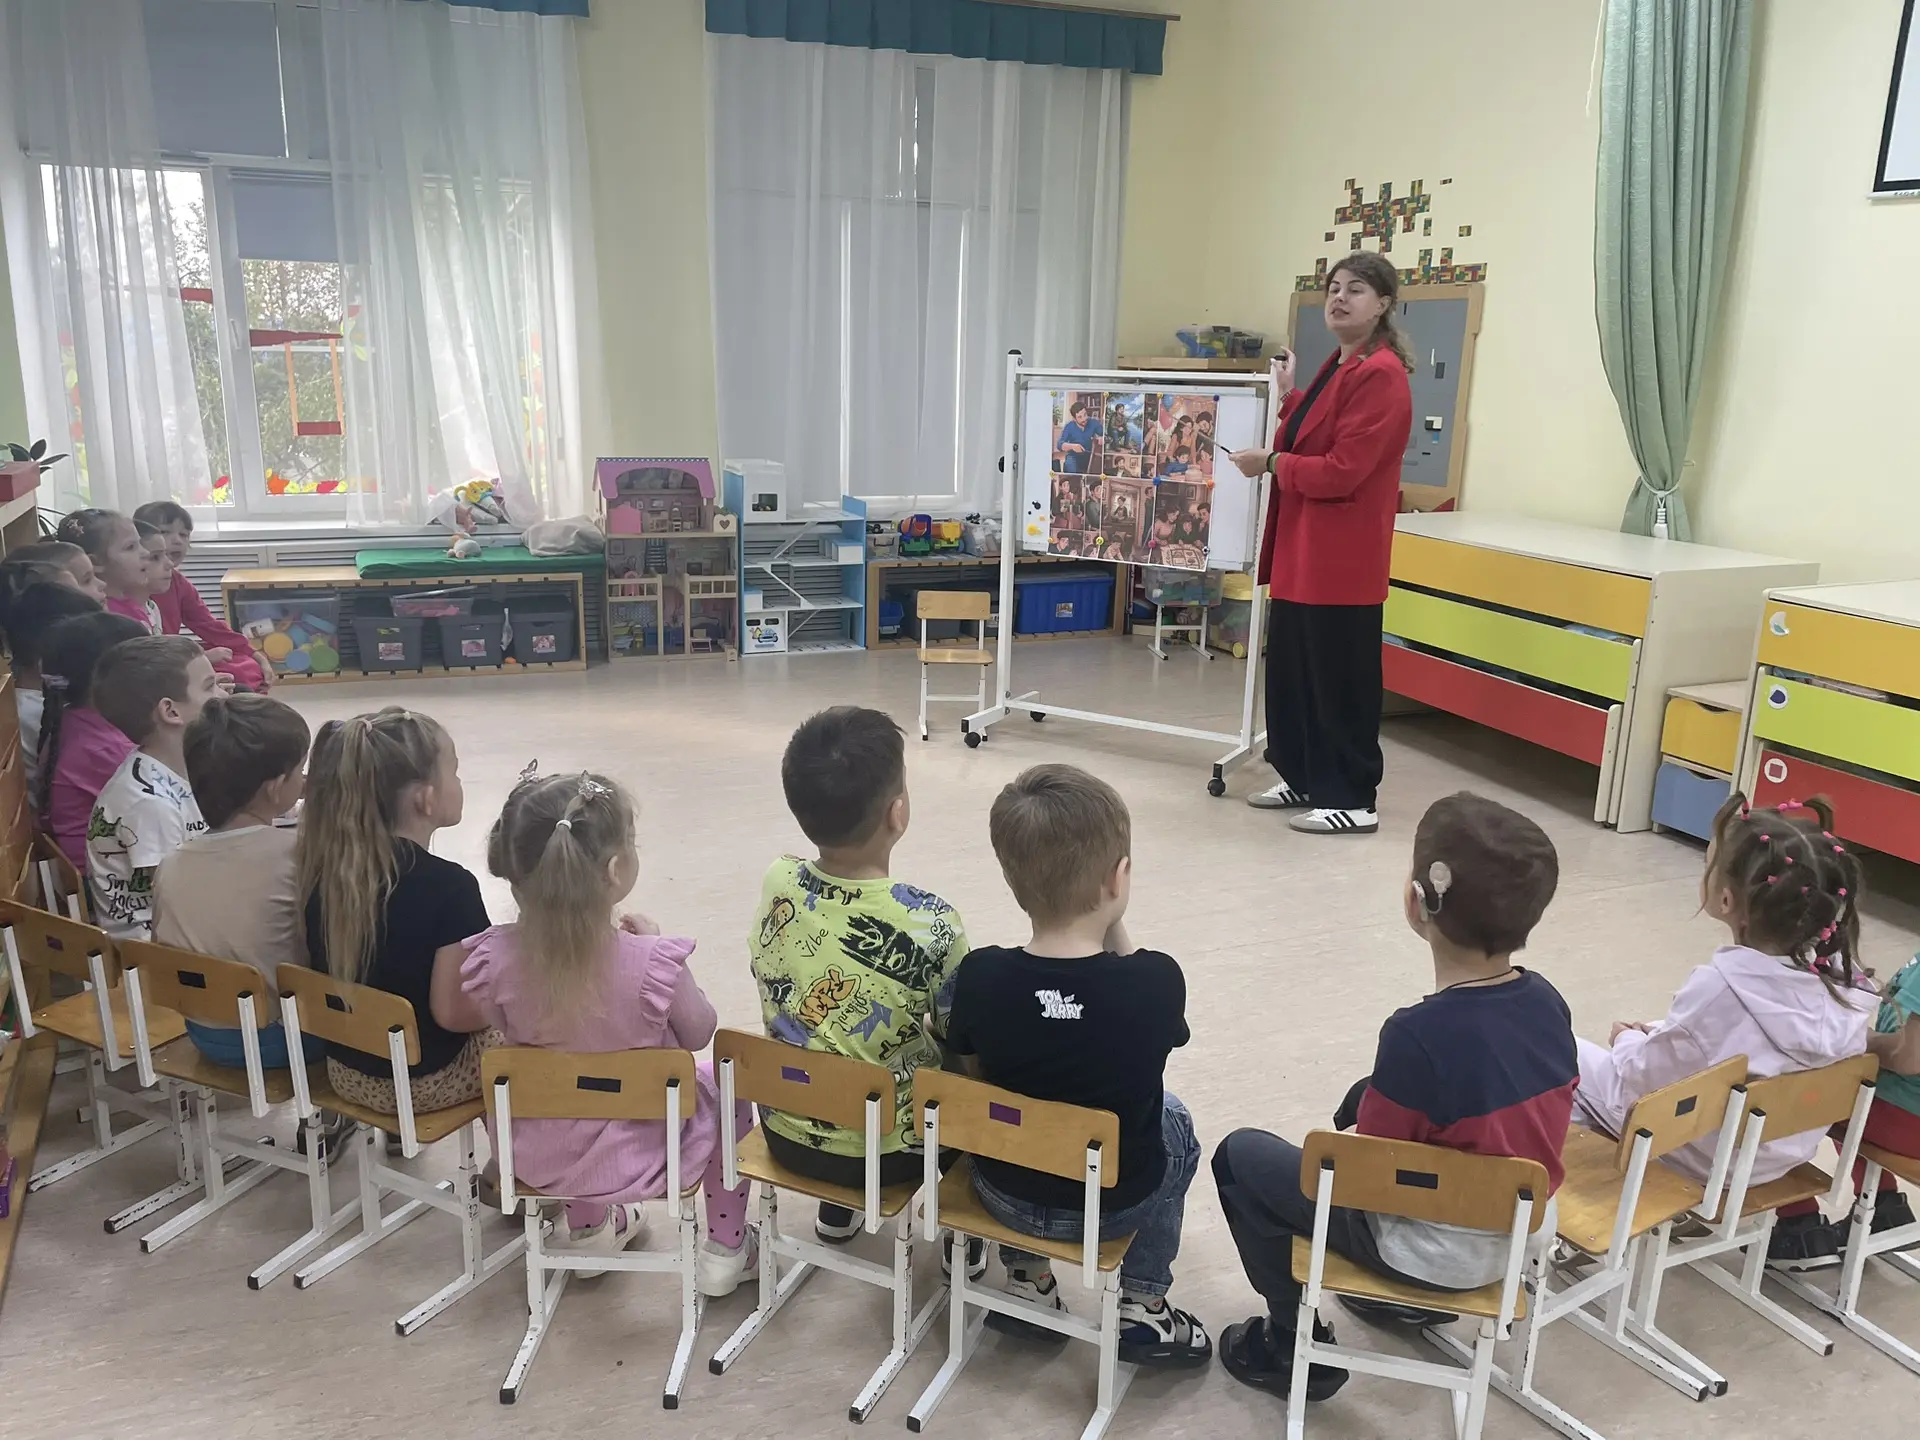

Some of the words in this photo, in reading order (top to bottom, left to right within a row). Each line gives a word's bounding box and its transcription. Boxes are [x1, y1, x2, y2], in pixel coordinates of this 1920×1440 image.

[801, 928, 829, 958] Vibe
[1034, 989, 1063, 1005] TOM
[1041, 1003, 1085, 1020] JERRY
